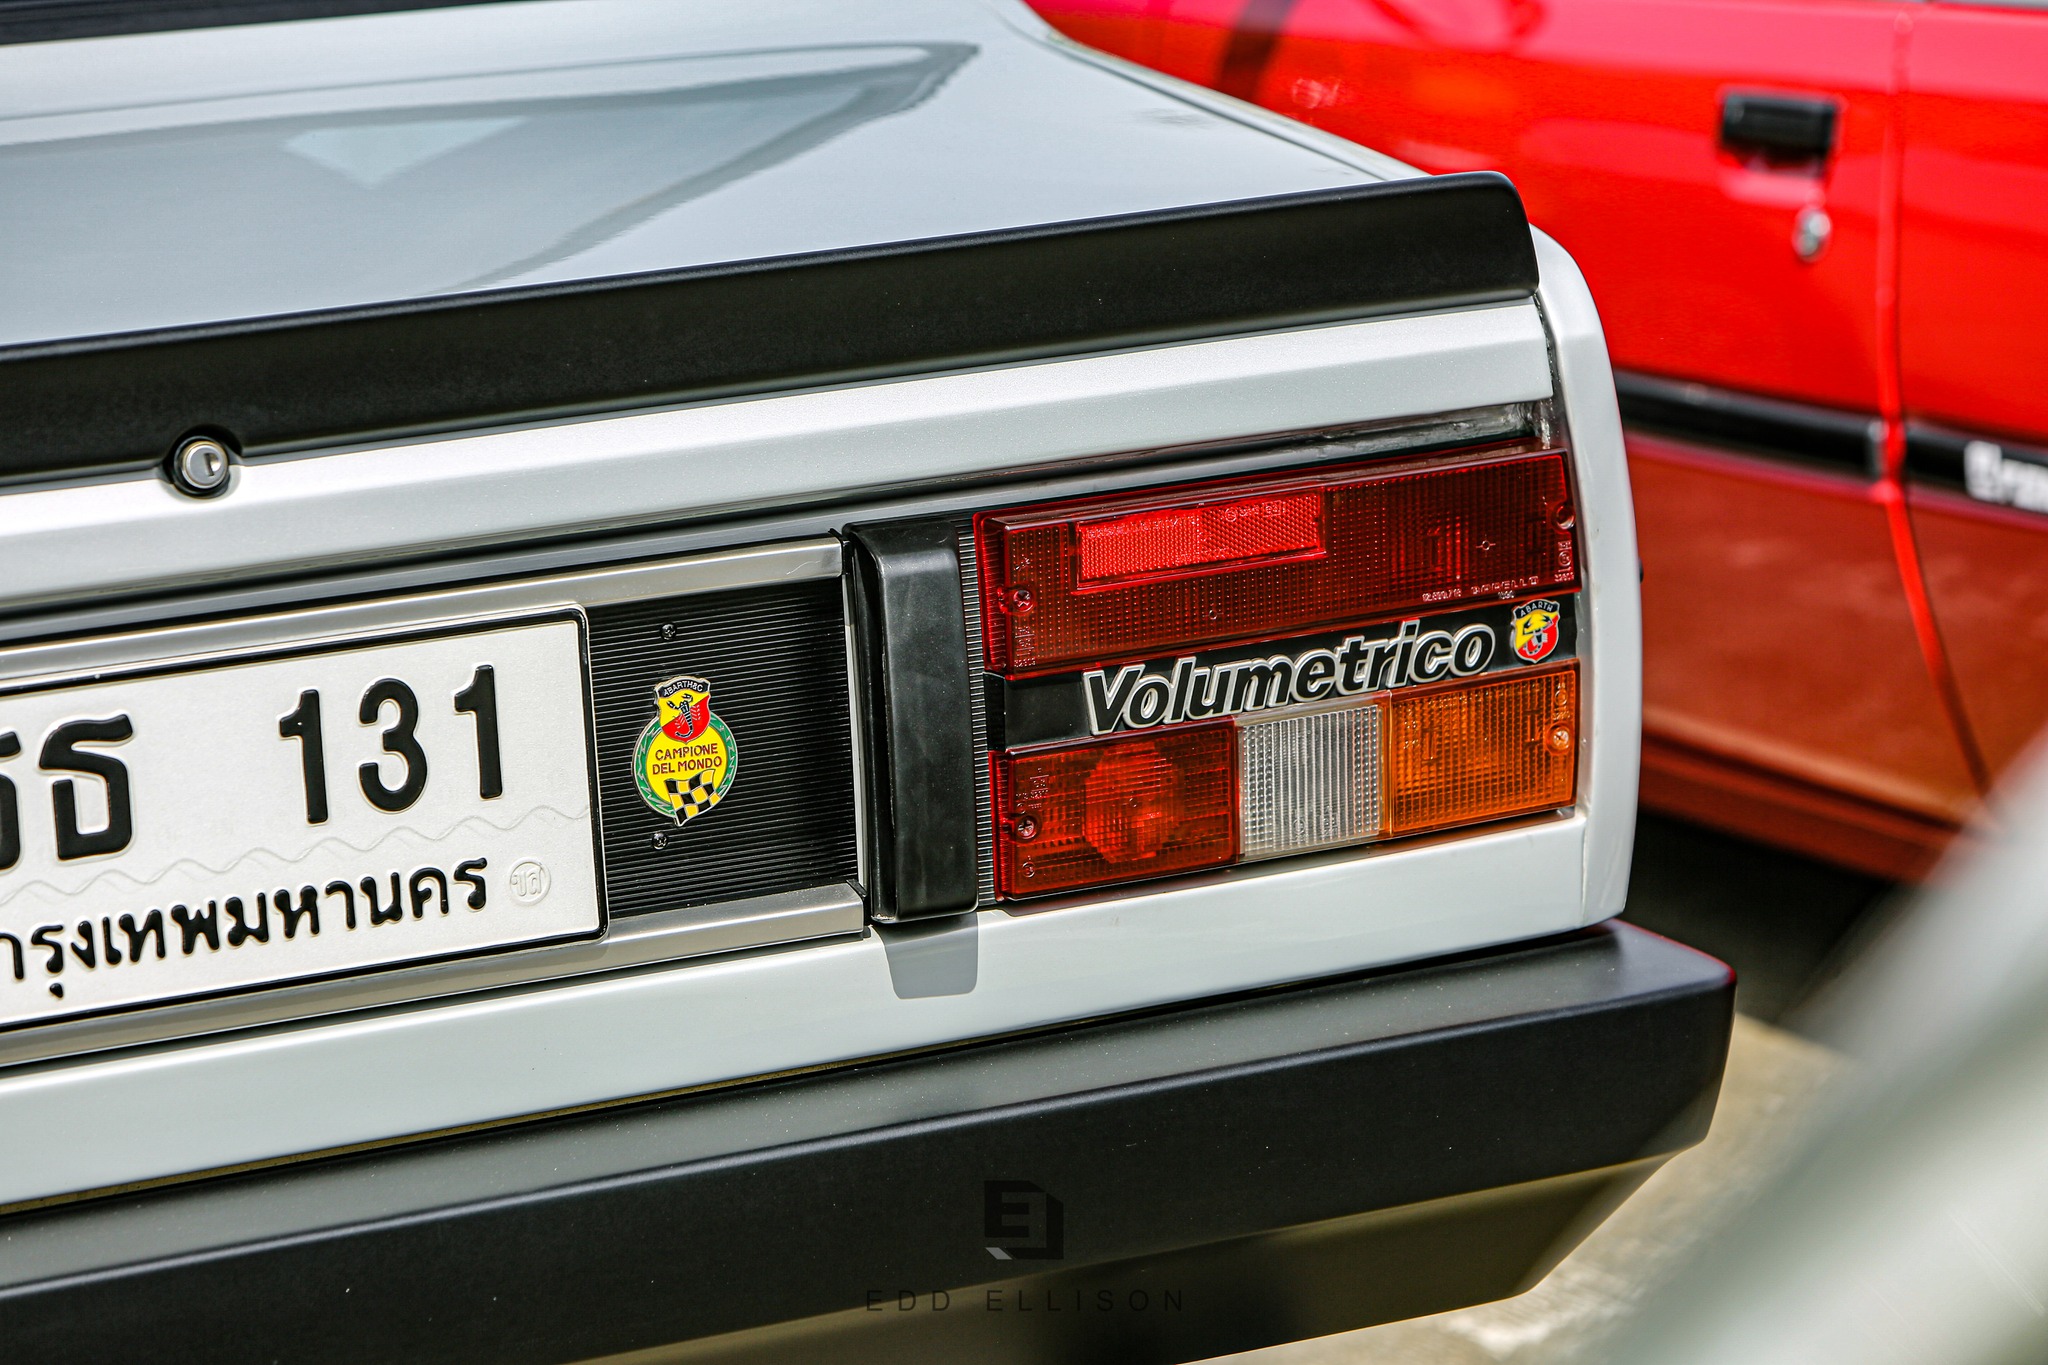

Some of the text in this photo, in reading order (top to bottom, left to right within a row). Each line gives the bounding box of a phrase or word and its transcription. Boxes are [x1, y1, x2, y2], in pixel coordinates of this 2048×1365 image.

[1520, 601, 1554, 617] ABARTH
[1082, 619, 1497, 736] Volumetrico
[278, 665, 503, 824] 131
[655, 743, 719, 762] CAMPIONE
[652, 756, 723, 775] DEL MONDO
